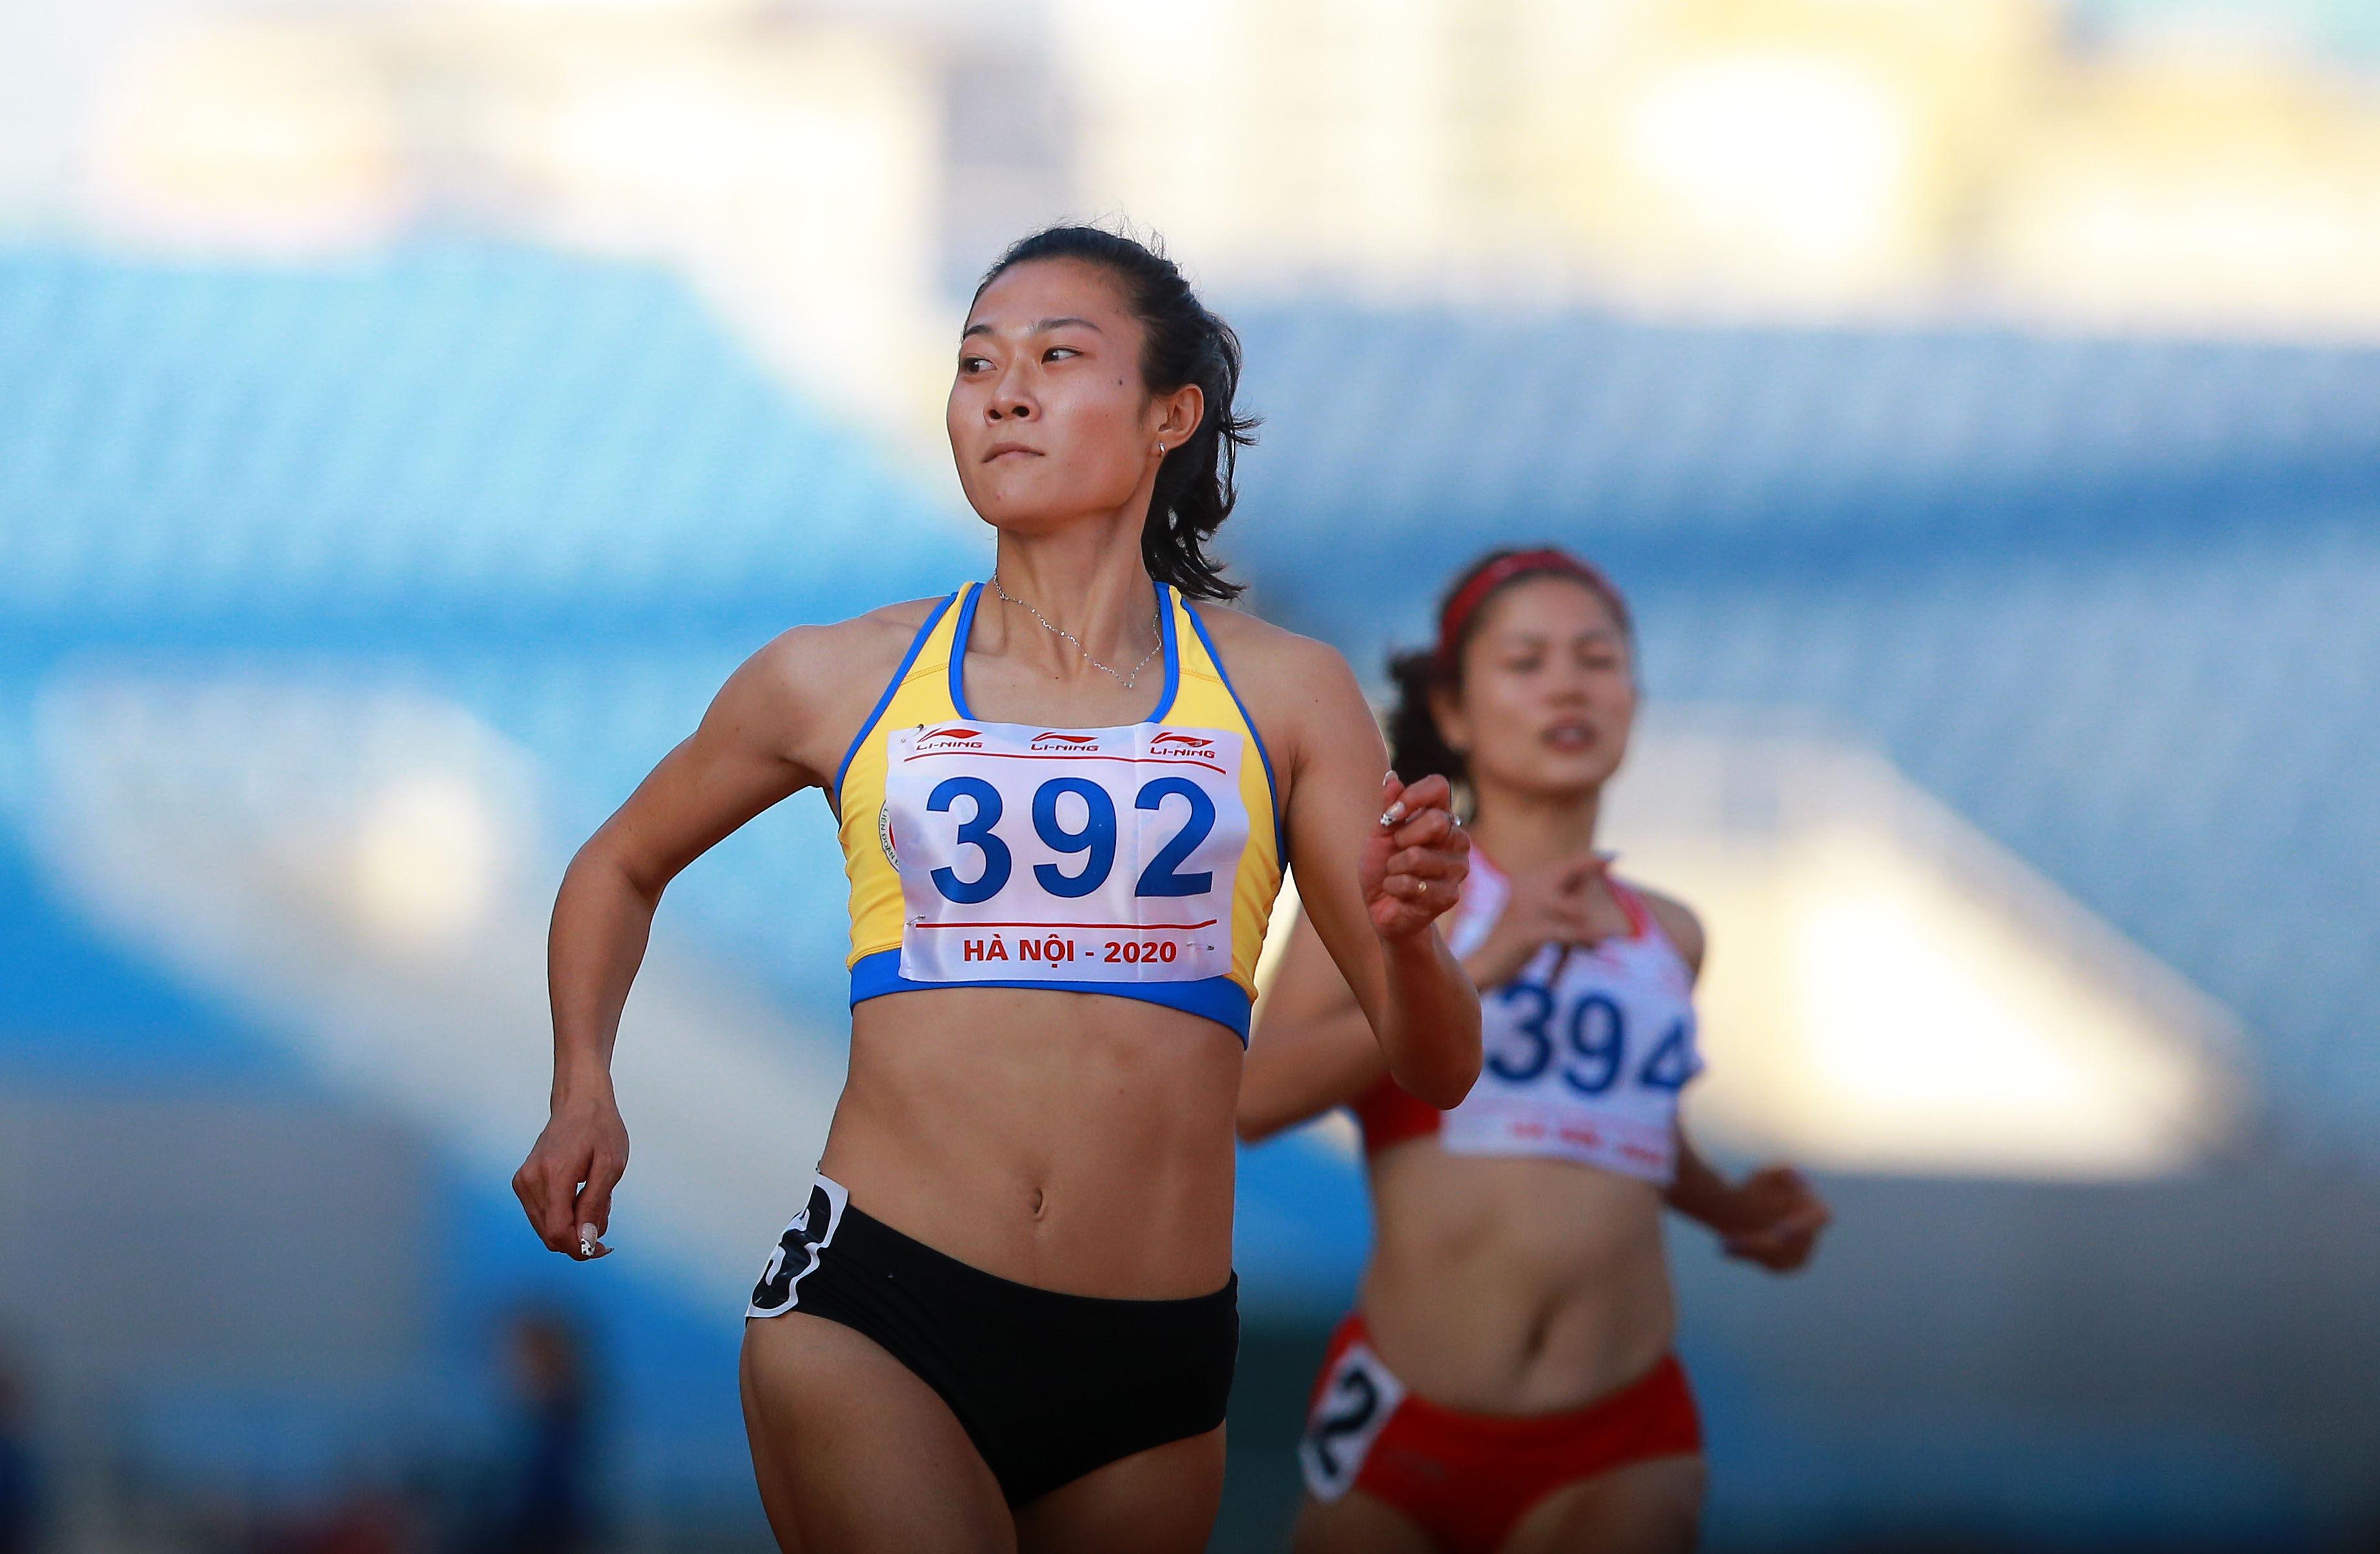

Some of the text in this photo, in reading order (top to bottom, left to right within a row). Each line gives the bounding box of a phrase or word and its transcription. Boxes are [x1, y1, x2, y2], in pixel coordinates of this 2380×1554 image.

[916, 742, 983, 751] LI-NING
[1031, 743, 1099, 752] LI-NING
[1150, 747, 1216, 759] LI-NING
[926, 776, 1216, 903] 392
[963, 934, 1009, 962] HÀ
[1020, 934, 1074, 968] NỘI
[1104, 942, 1177, 963] 2020
[1486, 980, 1700, 1097] 394
[1315, 1365, 1377, 1477] 2
